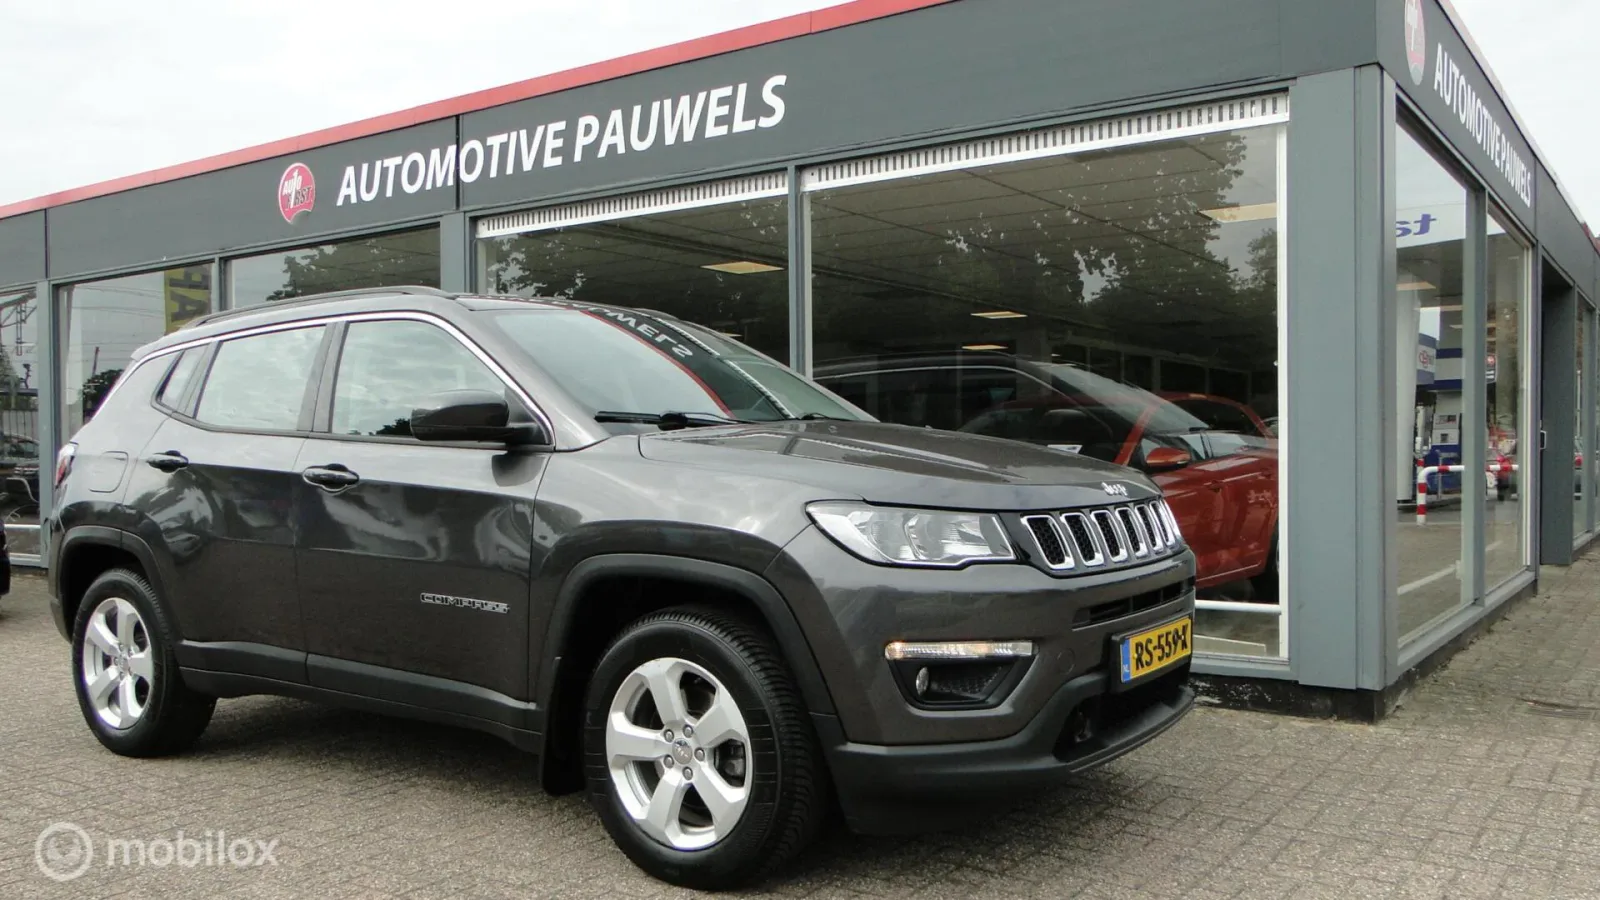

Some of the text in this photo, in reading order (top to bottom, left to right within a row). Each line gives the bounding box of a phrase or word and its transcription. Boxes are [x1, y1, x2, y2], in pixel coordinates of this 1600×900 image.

[336, 74, 787, 207] AUTOMOTIVE PAUWELS
[1434, 42, 1531, 208] AUTOMOTIVE PAUWELS
[420, 592, 510, 614] COMPASS
